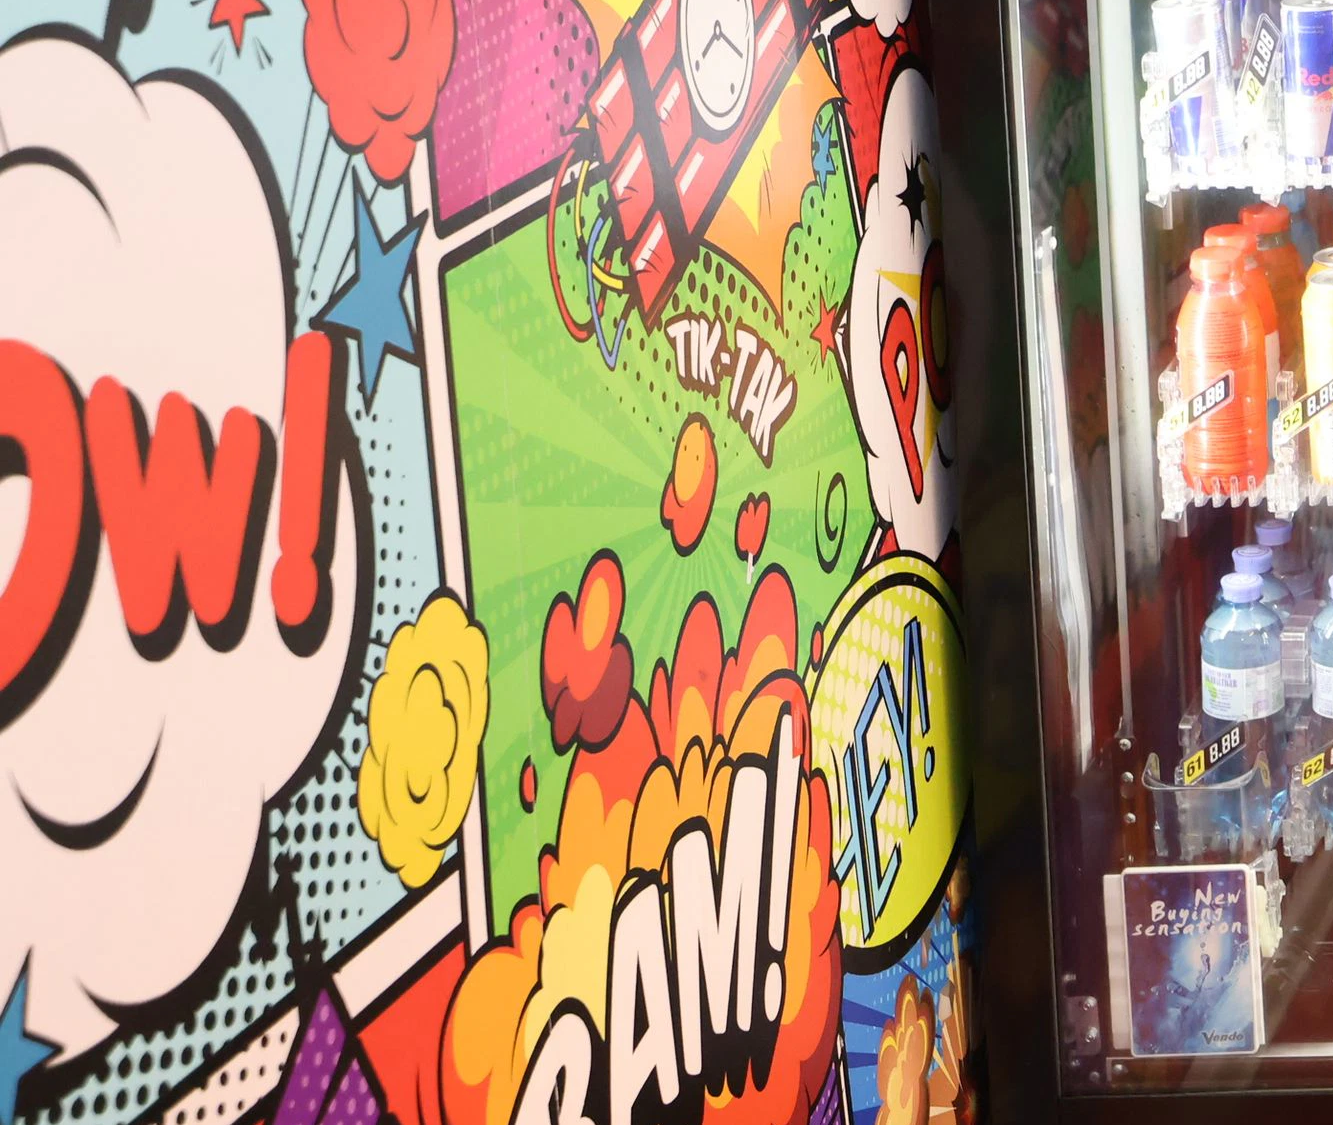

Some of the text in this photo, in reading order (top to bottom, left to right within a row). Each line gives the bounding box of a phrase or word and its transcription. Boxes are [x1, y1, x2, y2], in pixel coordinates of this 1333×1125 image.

[668, 315, 797, 467] TIK-TAK
[1186, 759, 1203, 780] 61
[1304, 760, 1321, 782] 62
[1195, 882, 1242, 907] New
[1151, 901, 1223, 925] Buying
[1132, 921, 1242, 937] sensation
[1202, 1029, 1244, 1045] Vendo
